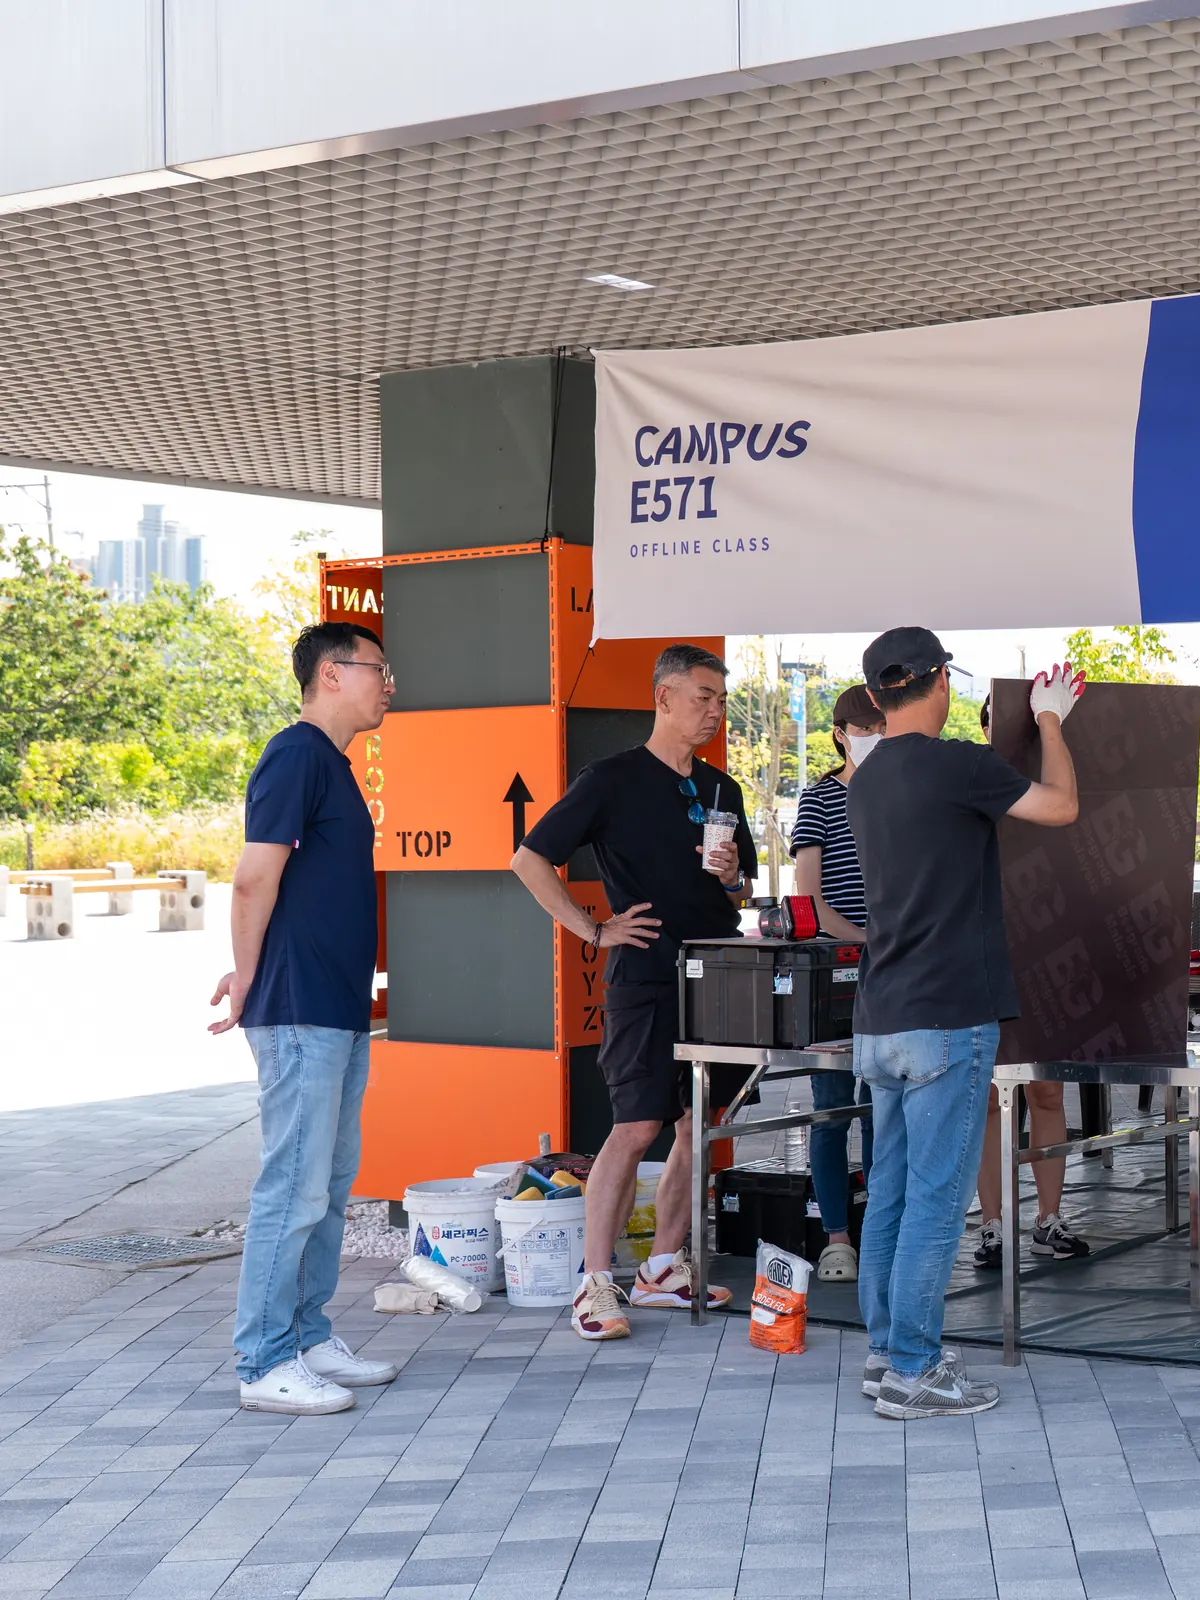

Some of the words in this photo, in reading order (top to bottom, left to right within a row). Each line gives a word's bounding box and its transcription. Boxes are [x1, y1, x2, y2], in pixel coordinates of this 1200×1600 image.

[635, 420, 811, 467] CAMPUS
[630, 476, 718, 523] E571
[630, 540, 701, 559] OFFLINE
[712, 537, 770, 554] CLASS
[396, 830, 451, 857] TOP
[441, 1227, 489, 1239] 세라픽스
